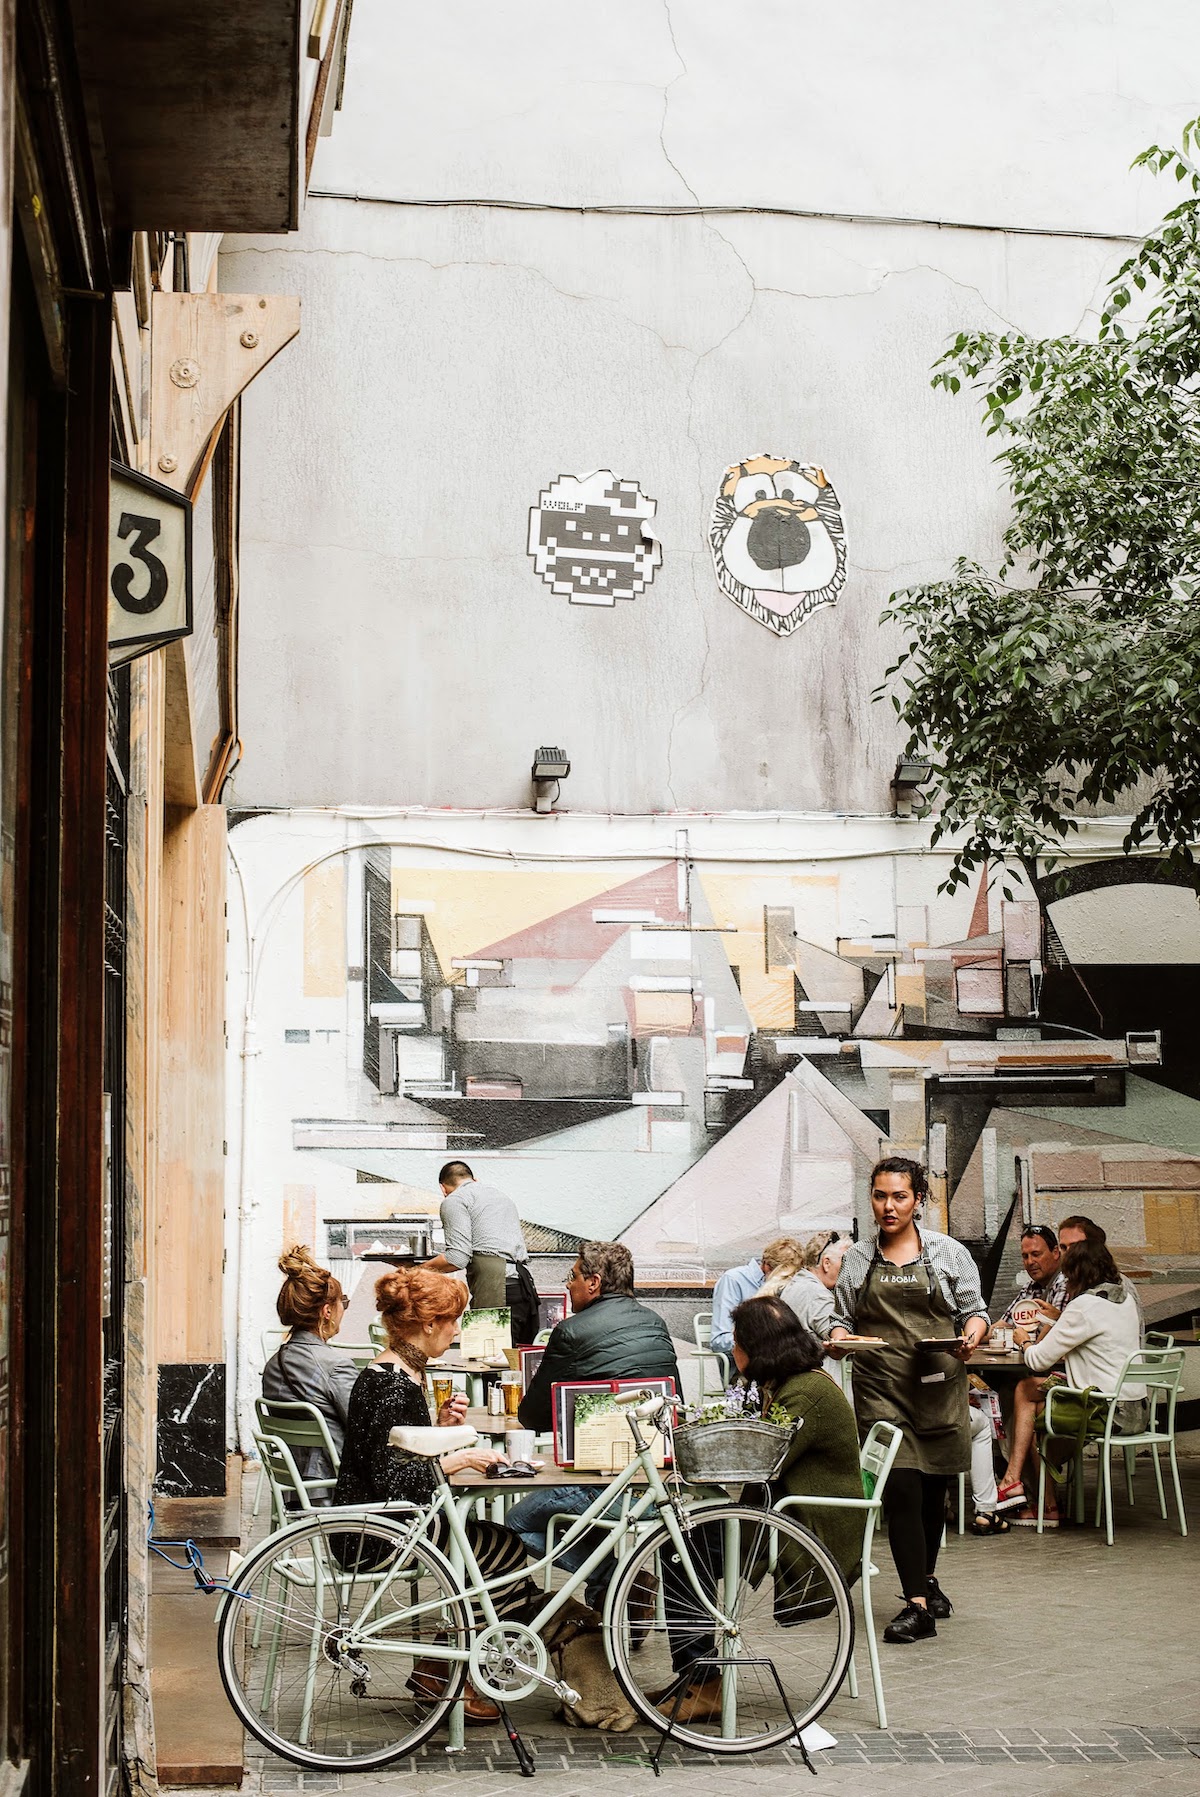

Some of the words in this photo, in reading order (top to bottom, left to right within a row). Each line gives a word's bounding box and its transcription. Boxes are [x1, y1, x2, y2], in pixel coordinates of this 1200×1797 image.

[544, 500, 583, 511] WOLF
[111, 512, 168, 614] 3
[880, 1275, 889, 1283] LA
[891, 1274, 918, 1283] BOBIA
